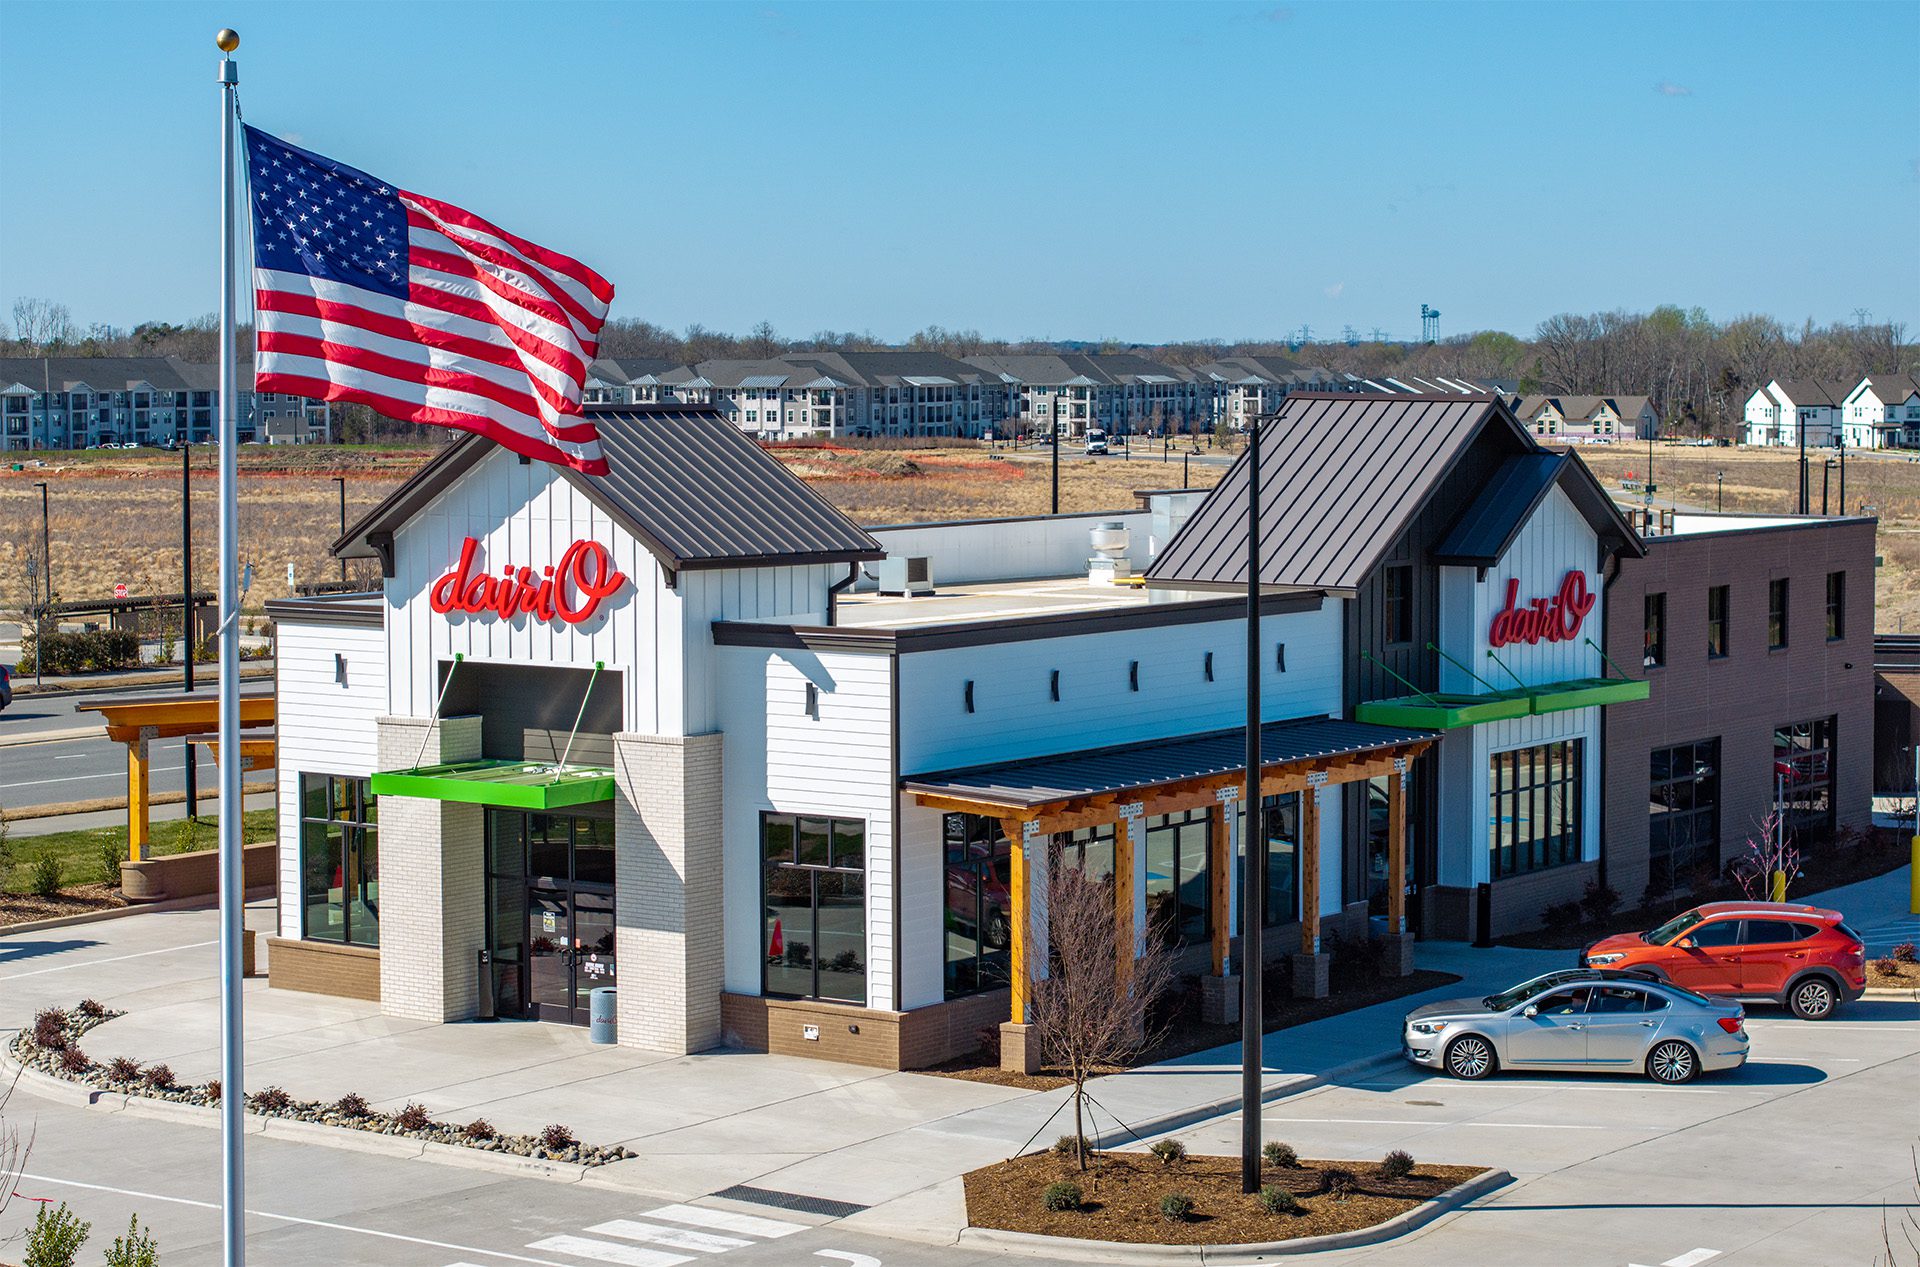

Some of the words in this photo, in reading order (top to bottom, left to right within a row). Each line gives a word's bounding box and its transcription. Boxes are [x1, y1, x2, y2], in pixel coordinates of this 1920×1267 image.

[115, 589, 128, 597] STOP
[430, 536, 626, 623] dairiO
[1489, 570, 1596, 648] dairiO
